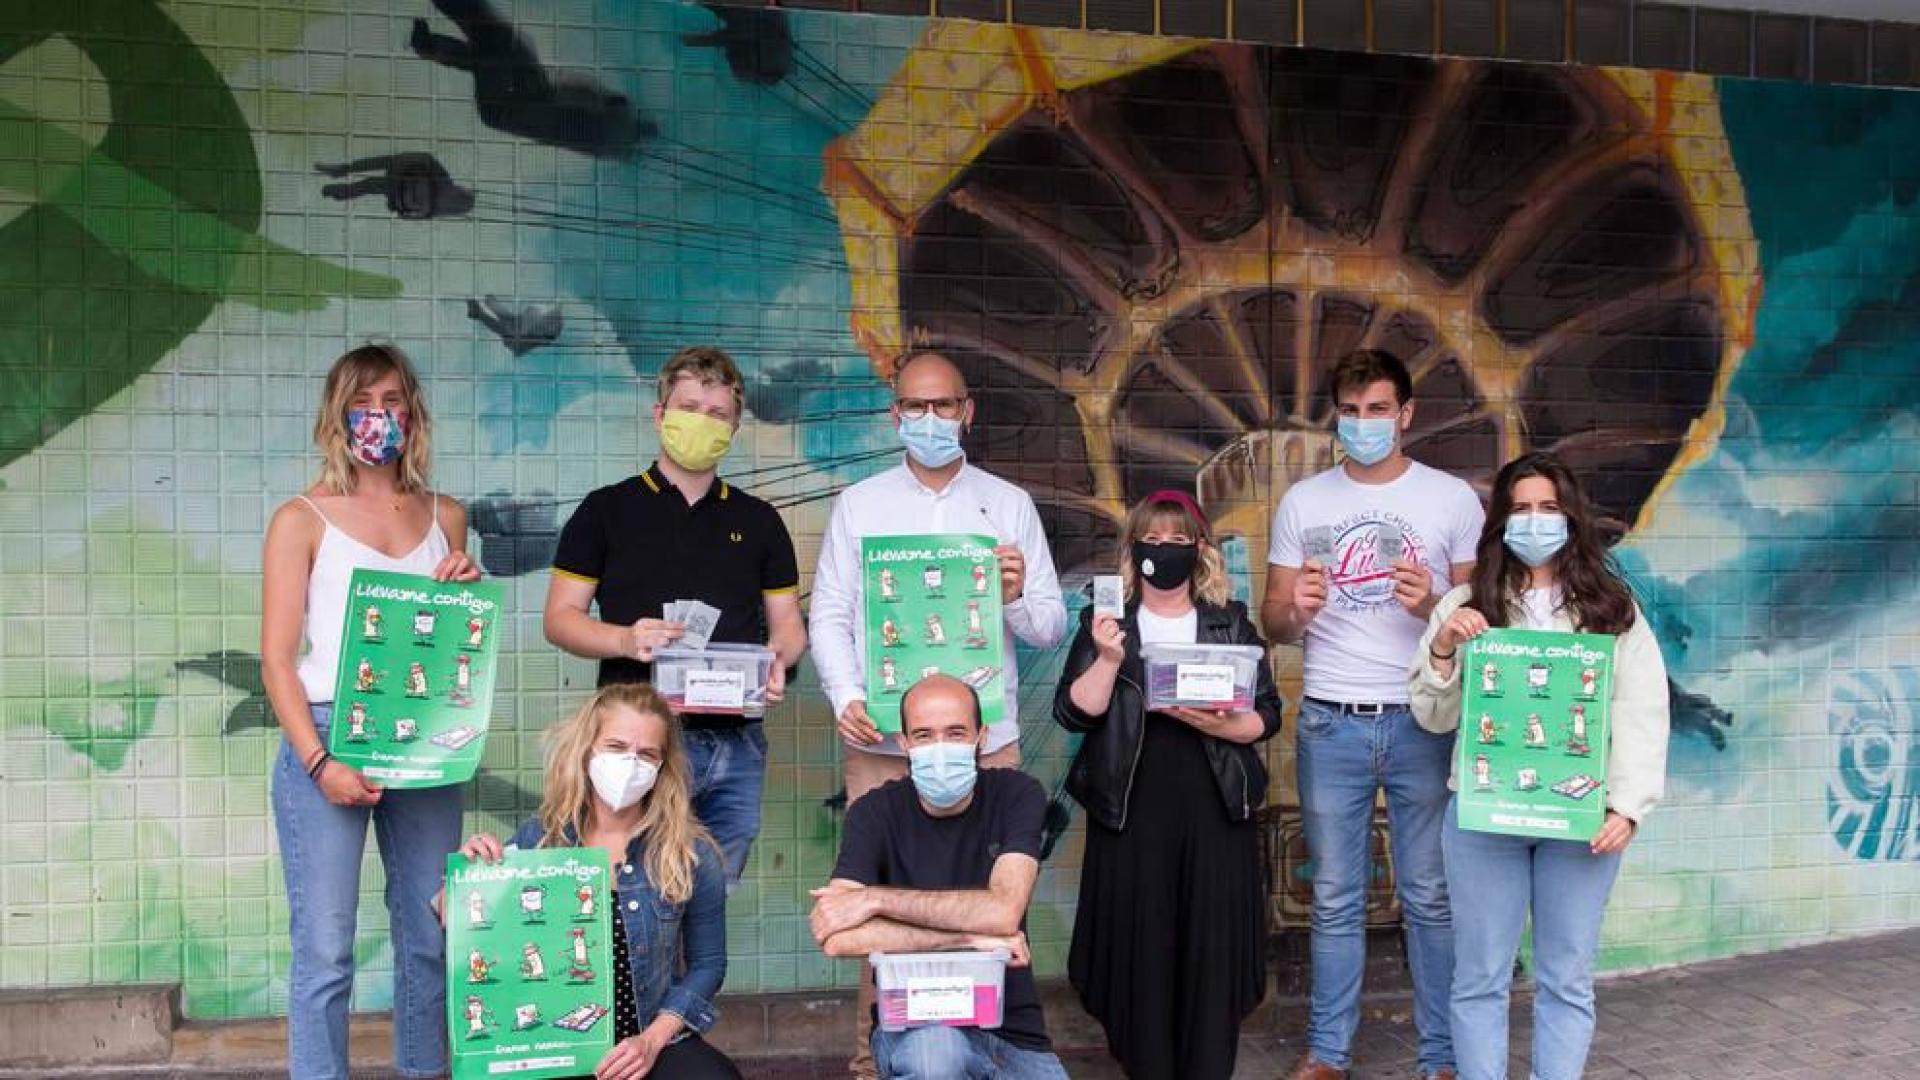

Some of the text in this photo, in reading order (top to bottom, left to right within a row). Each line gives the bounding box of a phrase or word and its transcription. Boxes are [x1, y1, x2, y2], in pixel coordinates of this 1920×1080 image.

[433, 589, 495, 614] contigo
[1545, 642, 1605, 665] contigo
[536, 857, 602, 881] contigo
